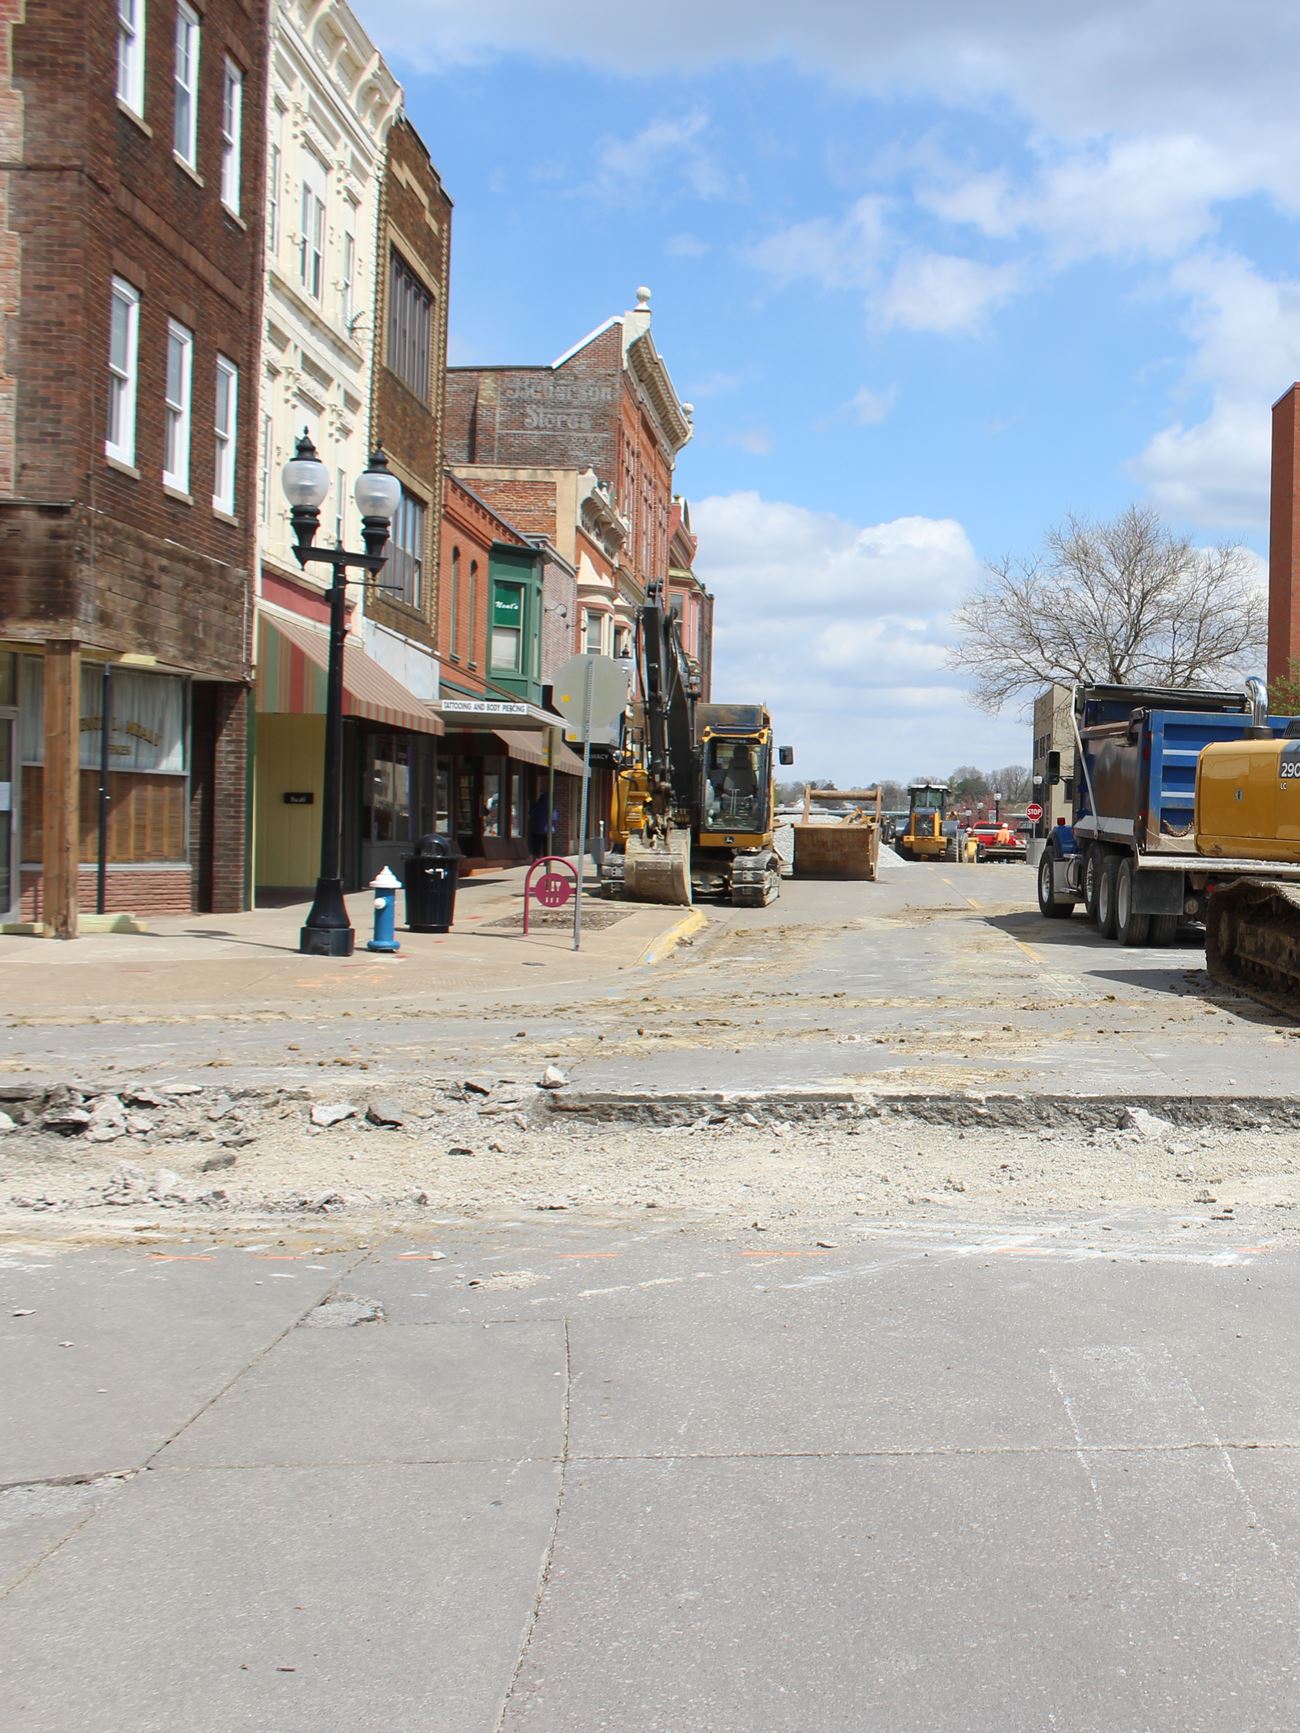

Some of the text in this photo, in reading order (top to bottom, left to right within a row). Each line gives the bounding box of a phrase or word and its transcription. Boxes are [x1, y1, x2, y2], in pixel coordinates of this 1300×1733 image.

[444, 701, 525, 713] TATTOOING AND BODY PIERCING
[1280, 782, 1287, 790] LC
